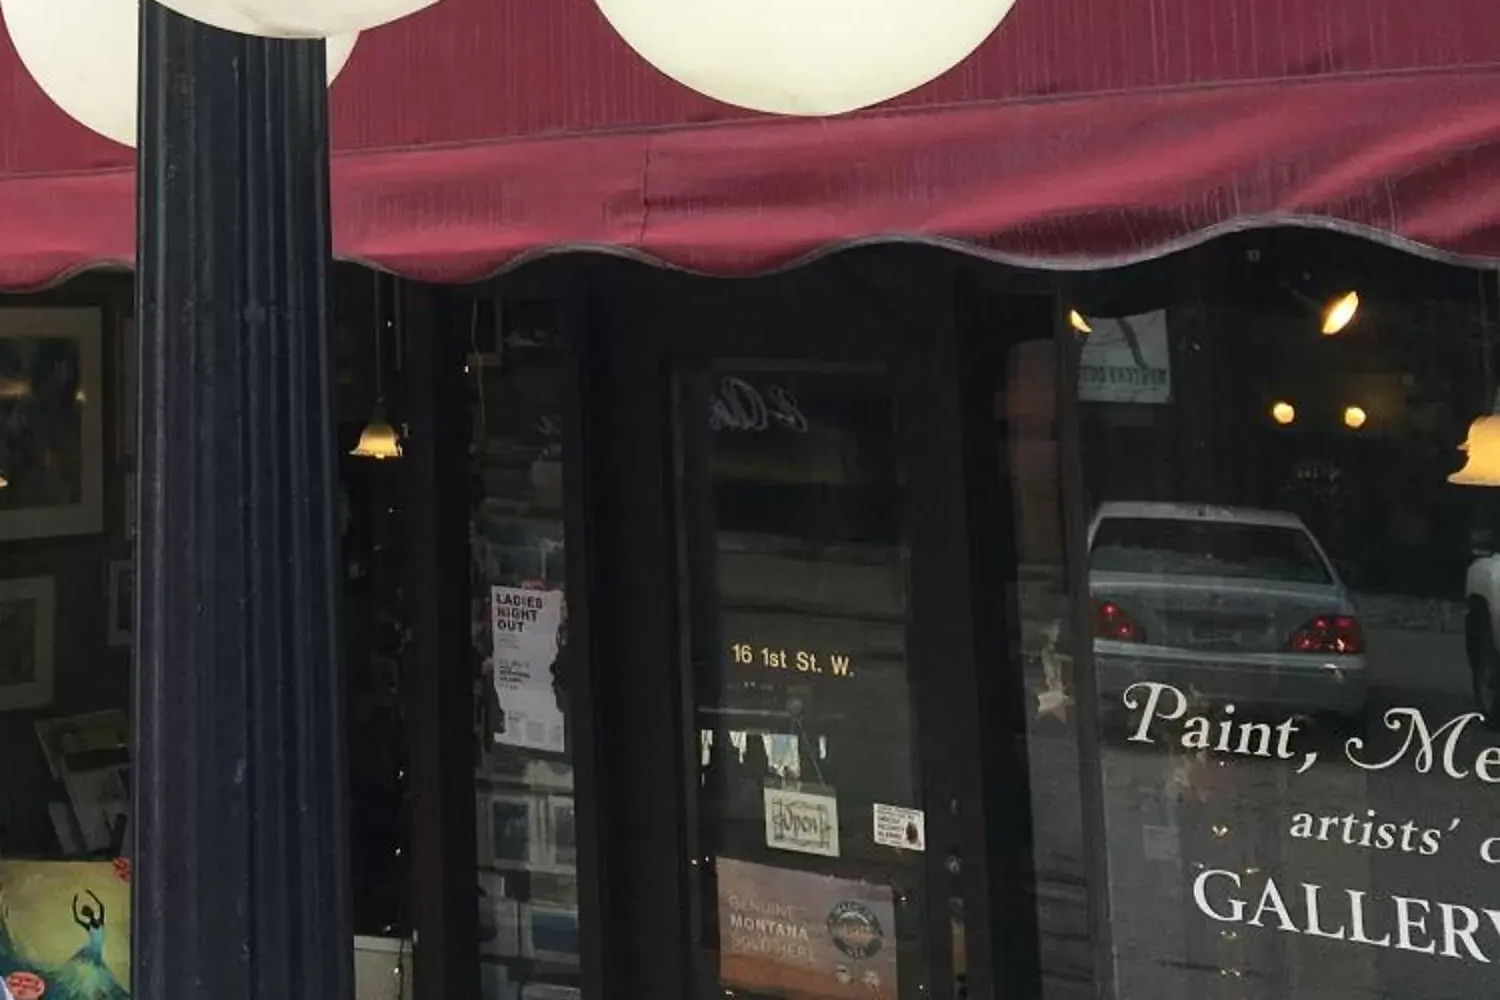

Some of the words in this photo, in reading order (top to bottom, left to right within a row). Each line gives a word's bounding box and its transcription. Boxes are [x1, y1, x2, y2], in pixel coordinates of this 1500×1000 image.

[497, 619, 523, 633] OUT
[732, 643, 753, 664] 16
[761, 647, 787, 669] 1st
[796, 650, 822, 673] St.
[830, 655, 854, 678] W.
[1123, 681, 1319, 774] Paint,
[1289, 809, 1461, 856] artists'
[729, 912, 810, 943] MONTANA
